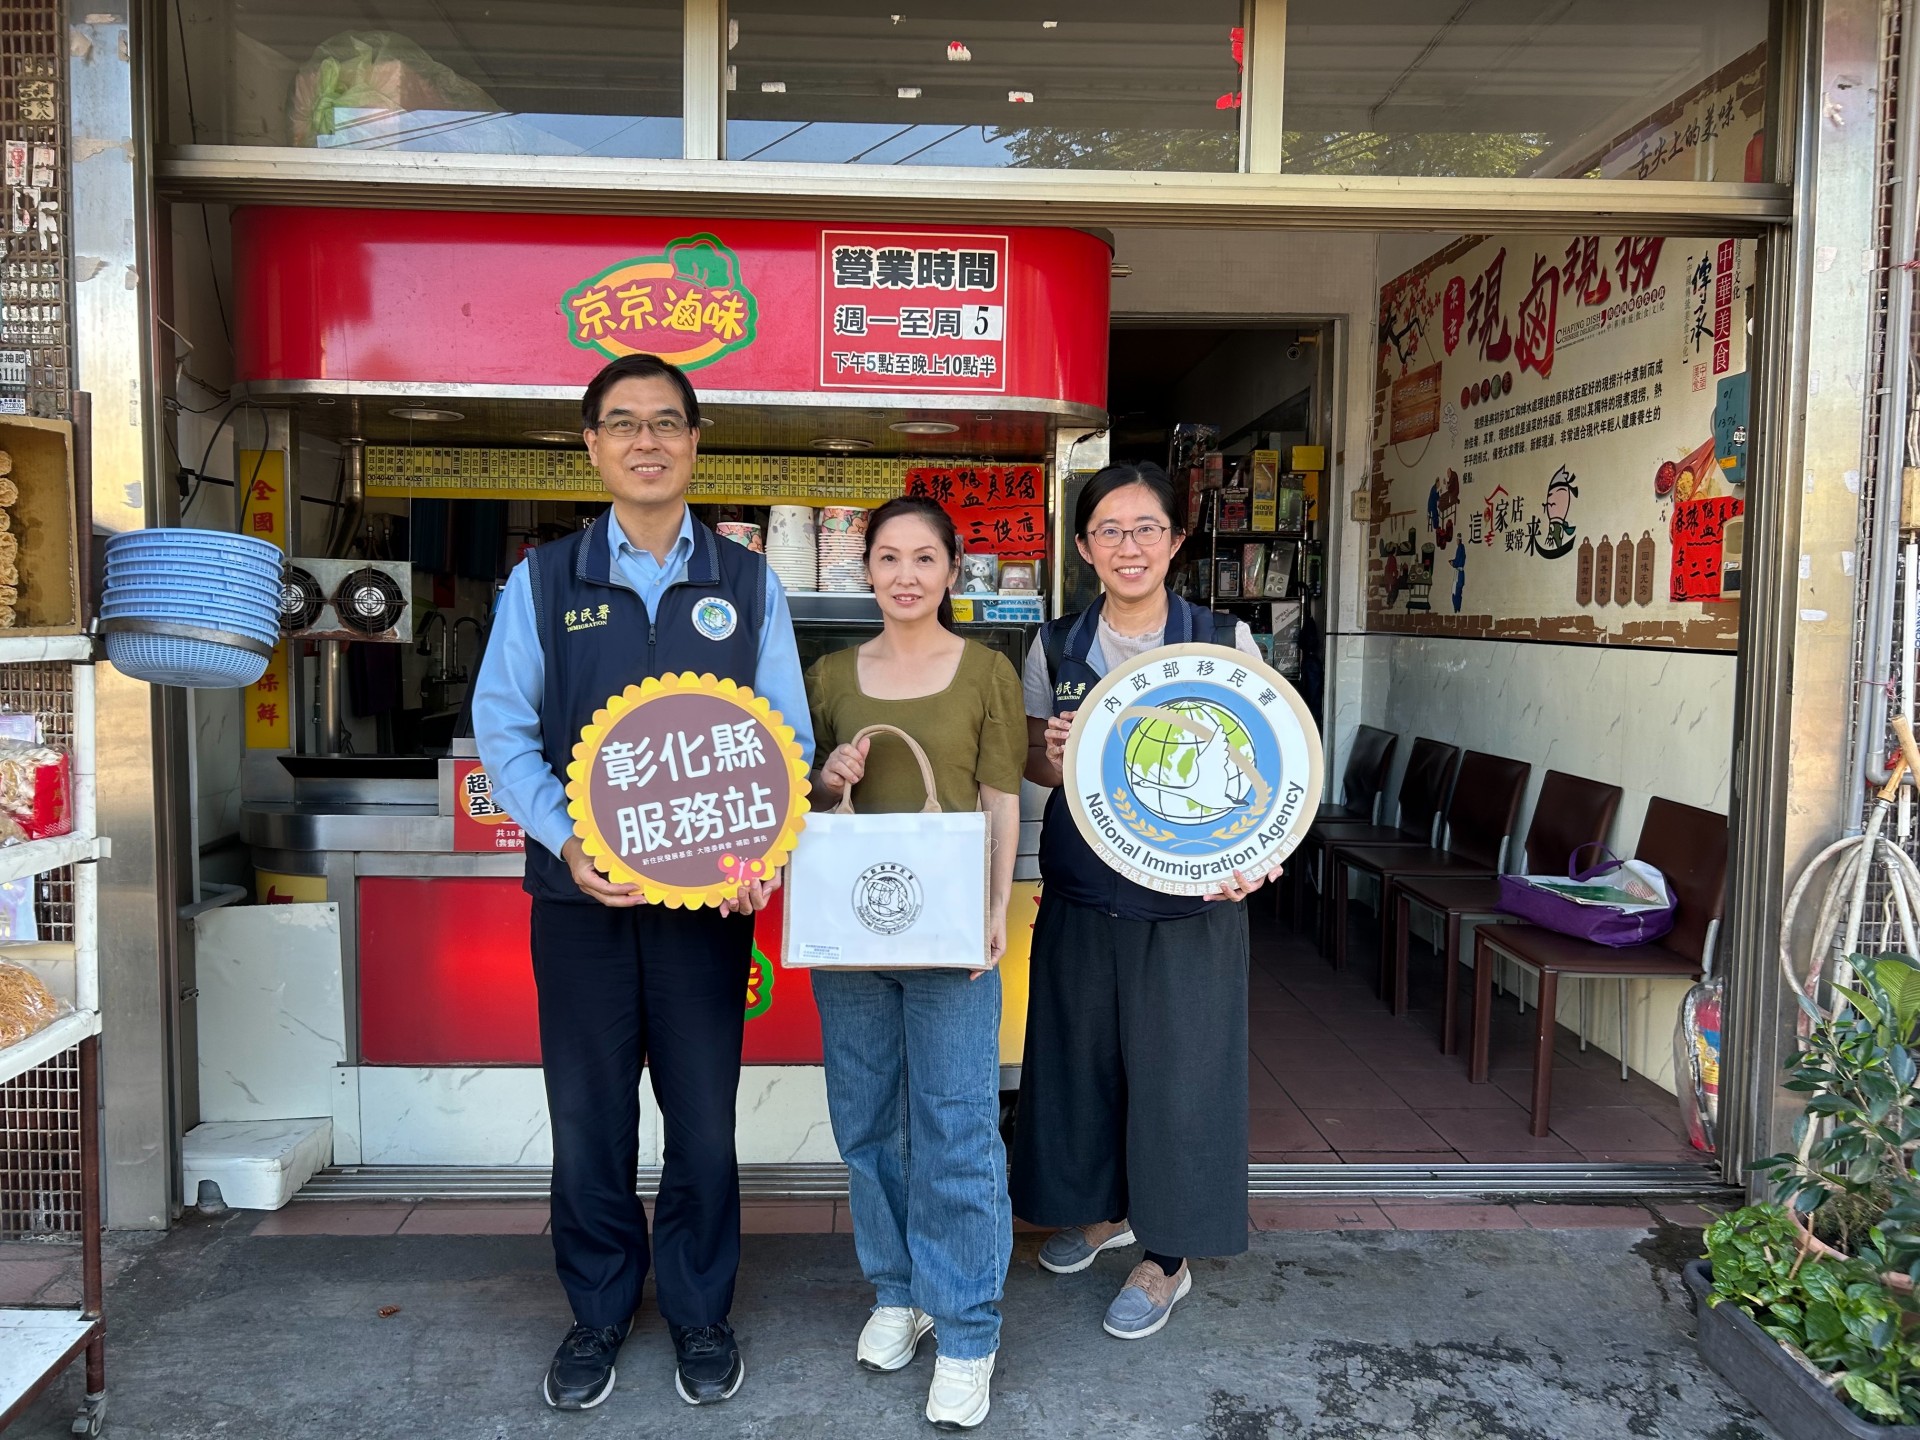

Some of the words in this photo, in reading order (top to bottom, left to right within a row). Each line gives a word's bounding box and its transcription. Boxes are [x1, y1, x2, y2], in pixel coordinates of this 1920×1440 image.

[833, 246, 996, 290] 營業時間
[572, 281, 749, 340] 京京滷味
[1713, 243, 1733, 372] 中華美食
[832, 351, 996, 376] 下午5點至晚上10點半
[251, 480, 277, 533] 全國
[564, 604, 611, 626] 移民署
[1103, 659, 1278, 714] 內政部移民署
[600, 717, 766, 792] 彰化縣
[616, 782, 777, 858] 服務站
[1085, 791, 1142, 860] National
[1142, 846, 1259, 881] Immigration
[1260, 780, 1304, 850] Agency
